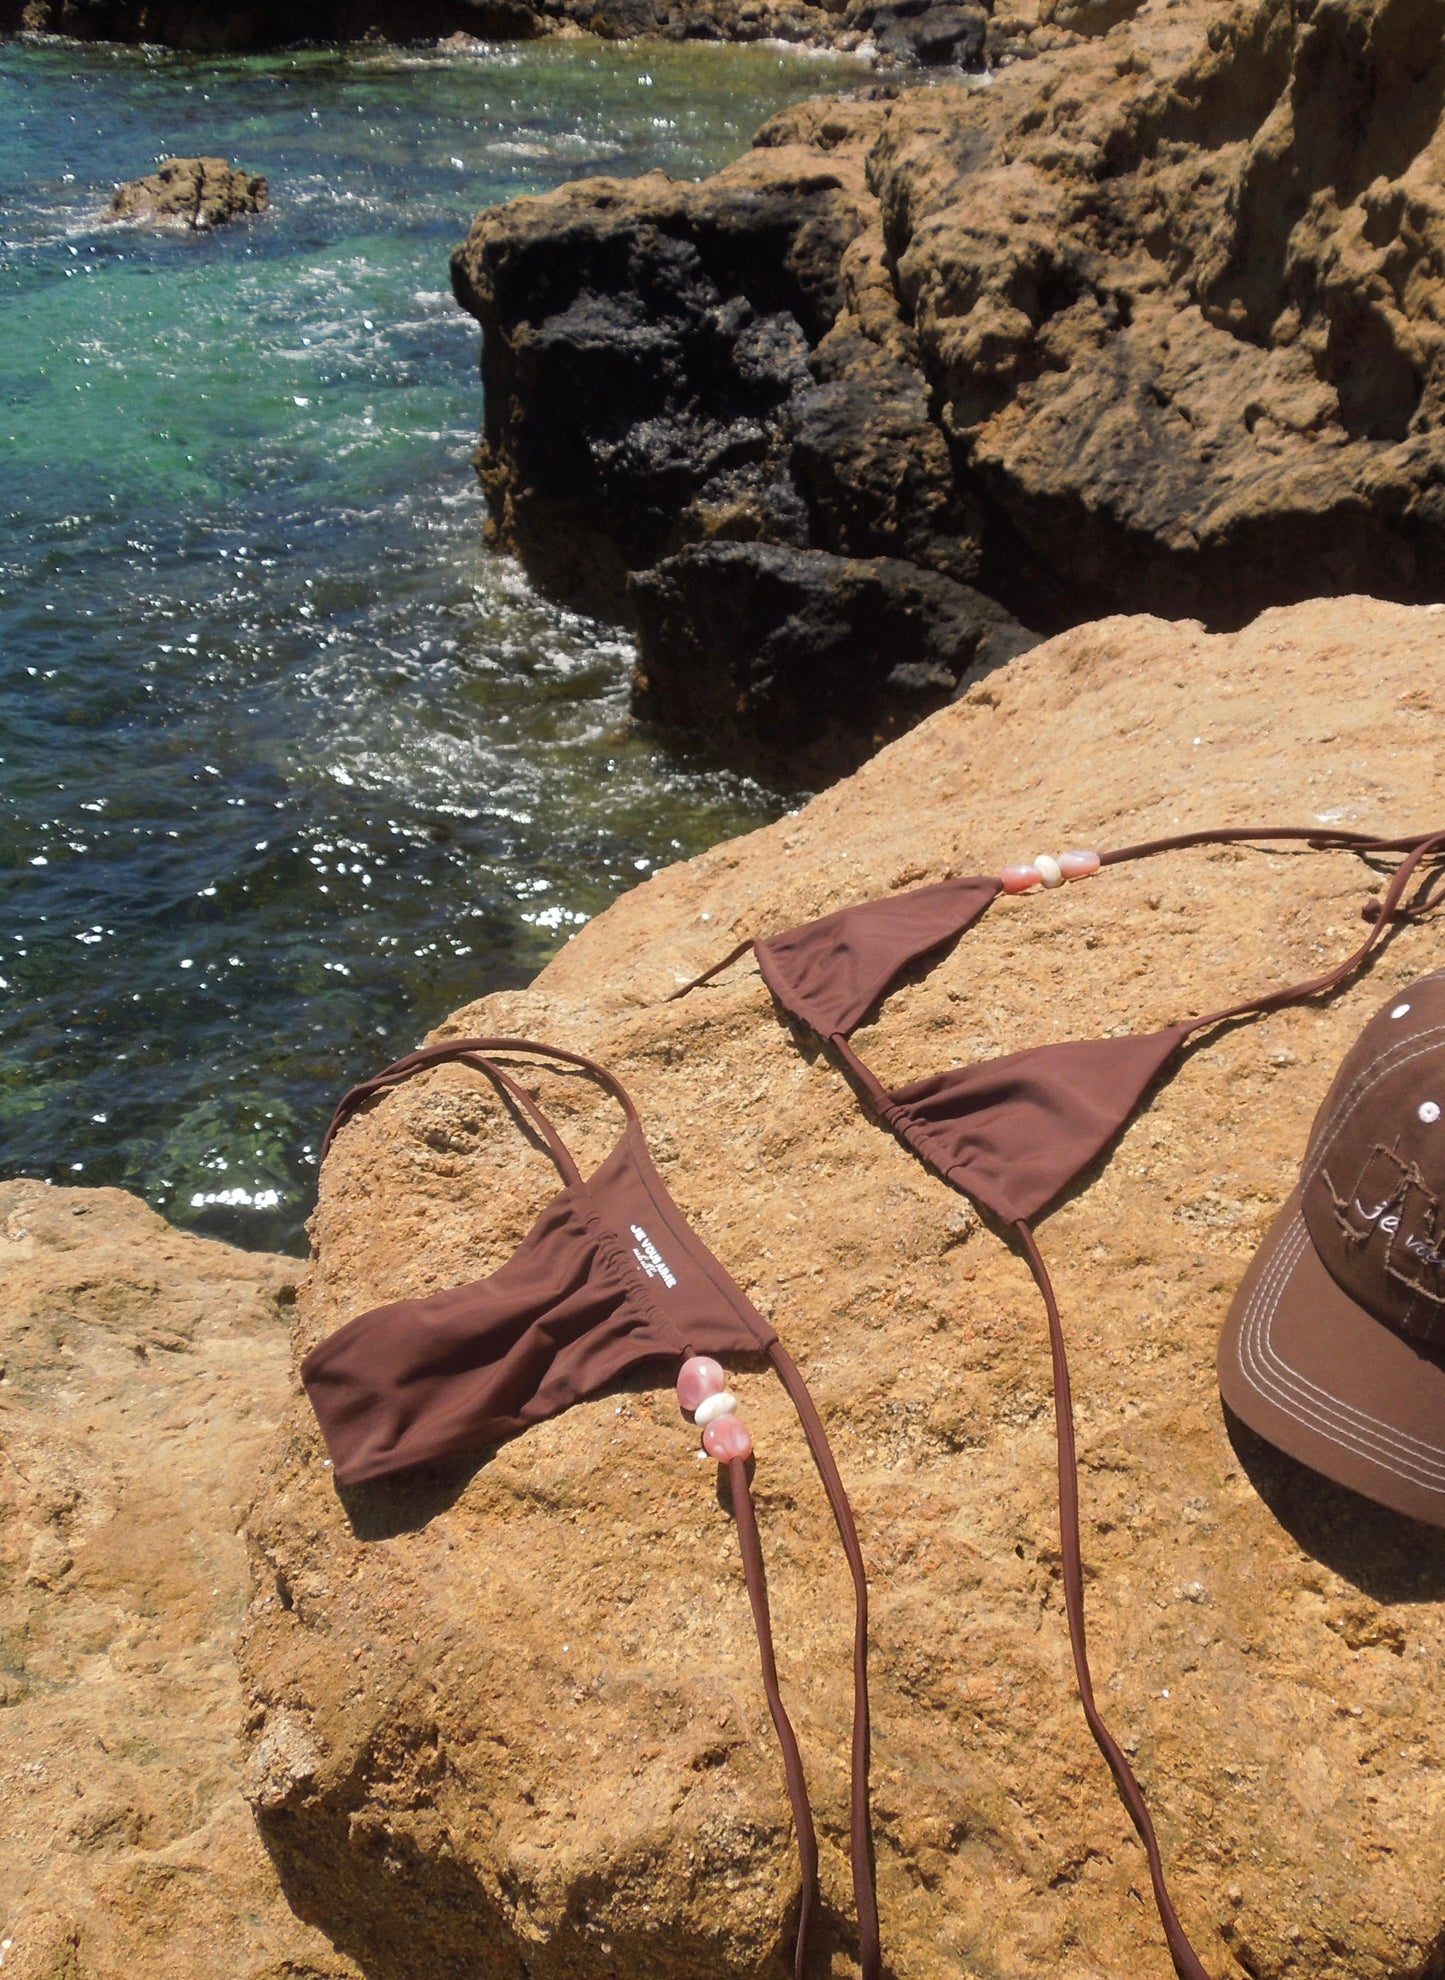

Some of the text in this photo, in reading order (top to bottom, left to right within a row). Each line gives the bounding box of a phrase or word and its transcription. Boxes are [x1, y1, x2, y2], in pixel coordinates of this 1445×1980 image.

[1356, 1198, 1400, 1233] Je
[630, 1224, 647, 1242] JE
[641, 1238, 663, 1264] VOUS
[656, 1263, 677, 1289] AIME
